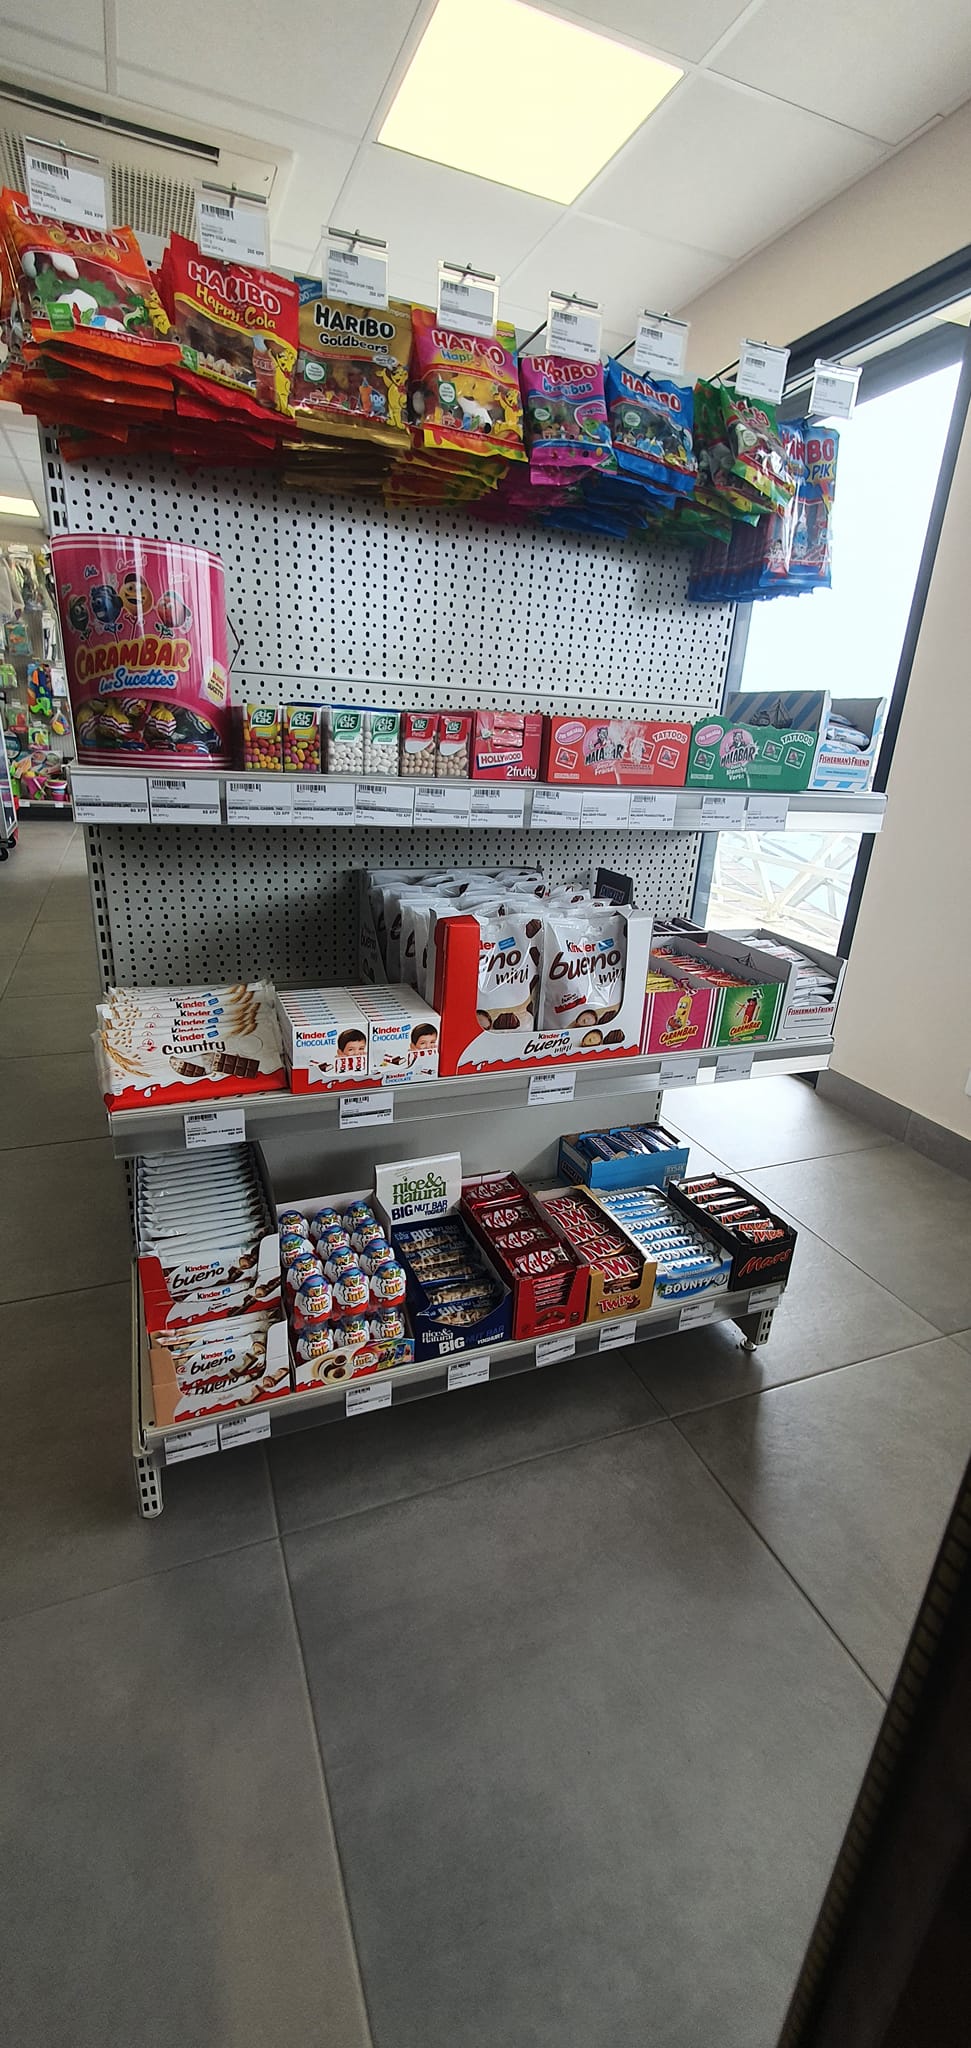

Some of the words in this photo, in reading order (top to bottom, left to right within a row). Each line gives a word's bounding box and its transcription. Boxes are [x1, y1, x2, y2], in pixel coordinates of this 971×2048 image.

[188, 261, 280, 314] HARIBO
[196, 283, 240, 321] Happy
[244, 306, 276, 329] Cola
[314, 303, 395, 340] HARIBO
[320, 333, 388, 354] Goldbears
[532, 357, 597, 384] HARIBO
[621, 371, 681, 412] HARIBO
[782, 429, 835, 464] HARBO
[76, 636, 190, 682] CARAMBAR
[113, 668, 176, 687] Sucettes
[653, 731, 687, 743] TATTOOS
[781, 734, 814, 746] TATTOOS
[481, 752, 521, 764] HOLLYWOOD
[585, 744, 624, 765] MALAAR
[720, 747, 755, 766] MALABAR
[851, 755, 870, 768] FRIEND
[506, 766, 537, 778] 2fruity
[496, 964, 529, 986] mini
[549, 950, 621, 981] bueno
[818, 1006, 834, 1014] FRIEND
[296, 1038, 336, 1047] CHOCOLATE
[372, 1034, 409, 1042] CHOCOLATE
[524, 1036, 571, 1054] bueno
[393, 1182, 447, 1205] natural
[391, 1204, 414, 1221] BIG
[414, 1202, 430, 1212] NUT
[431, 1200, 448, 1210] BAR
[410, 1228, 434, 1242] BIG
[738, 1249, 792, 1278] Mars
[172, 1267, 224, 1289] bueno
[664, 1276, 714, 1295] BOUNTY
[439, 1337, 465, 1355] BIG
[190, 1354, 236, 1375] bueno
